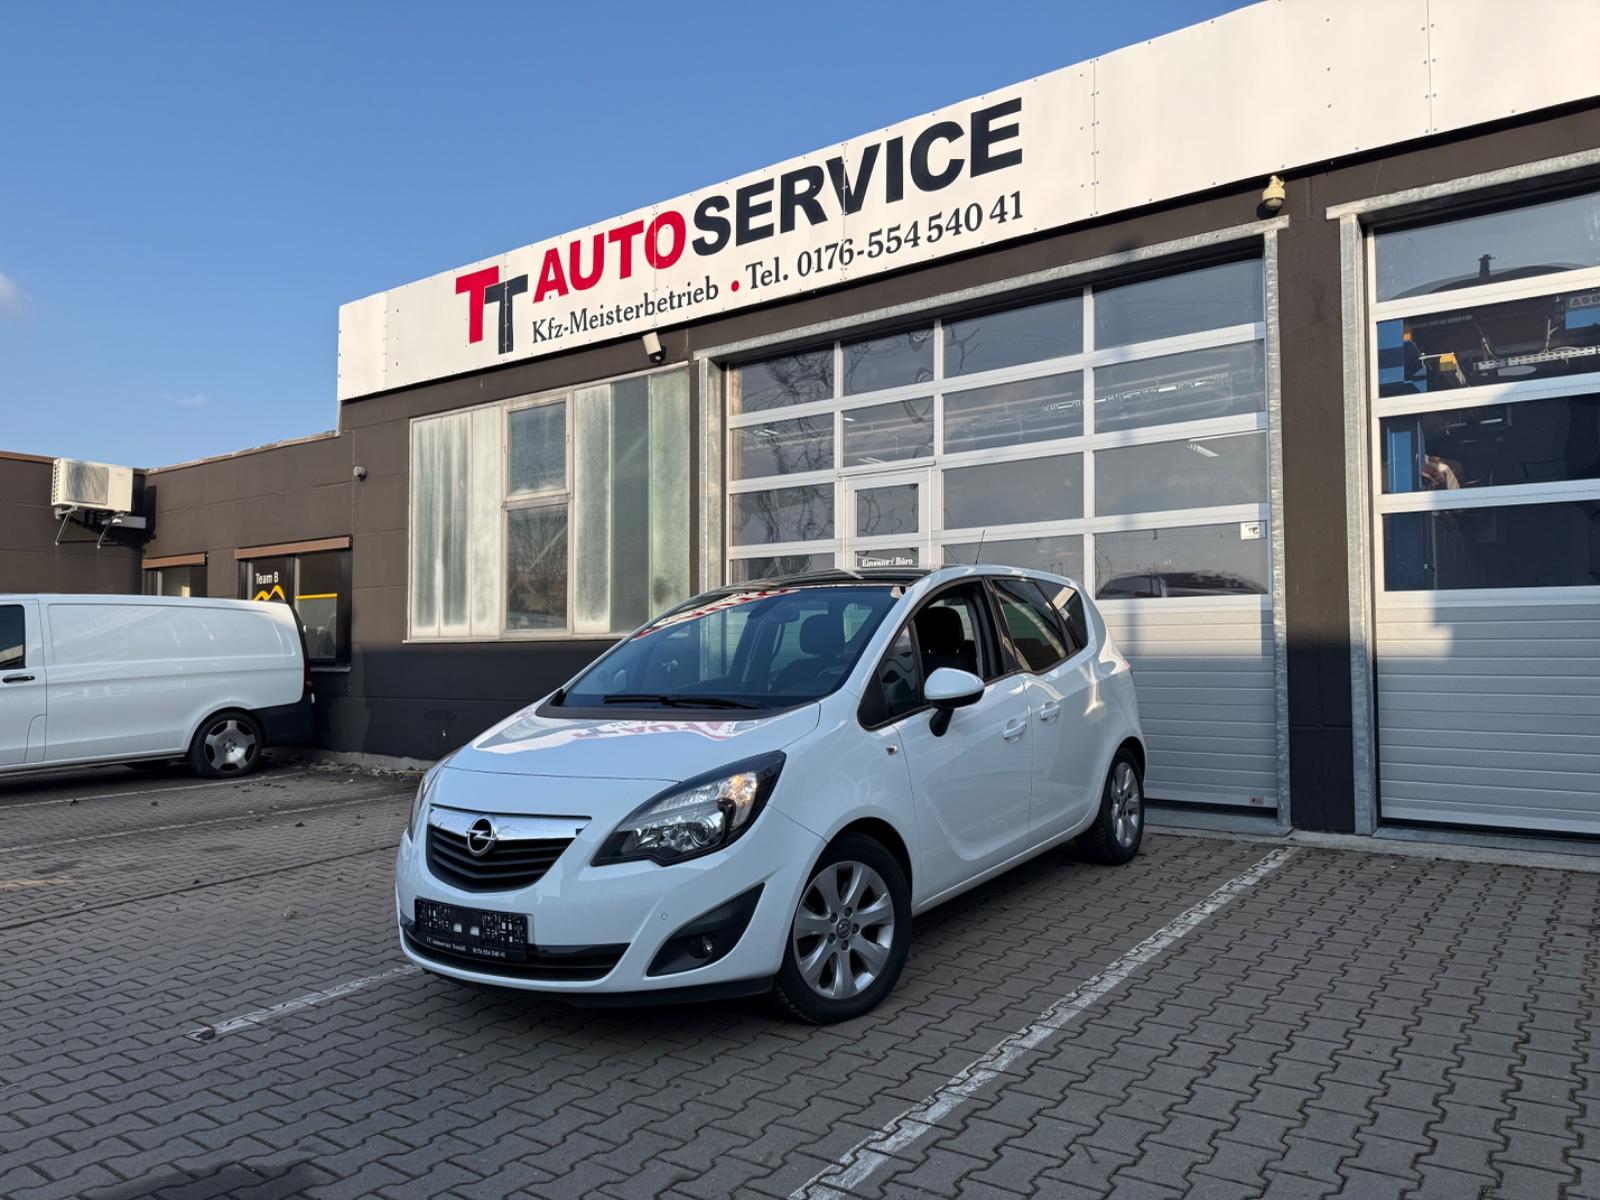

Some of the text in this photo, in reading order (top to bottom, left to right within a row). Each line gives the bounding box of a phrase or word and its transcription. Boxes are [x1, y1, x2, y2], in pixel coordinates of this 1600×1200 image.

[455, 97, 1023, 355] TT AUTOSERVICE
[532, 275, 719, 344] Kfz-Meisterbetrieb
[745, 257, 789, 290] Tel.
[255, 573, 273, 584] Team
